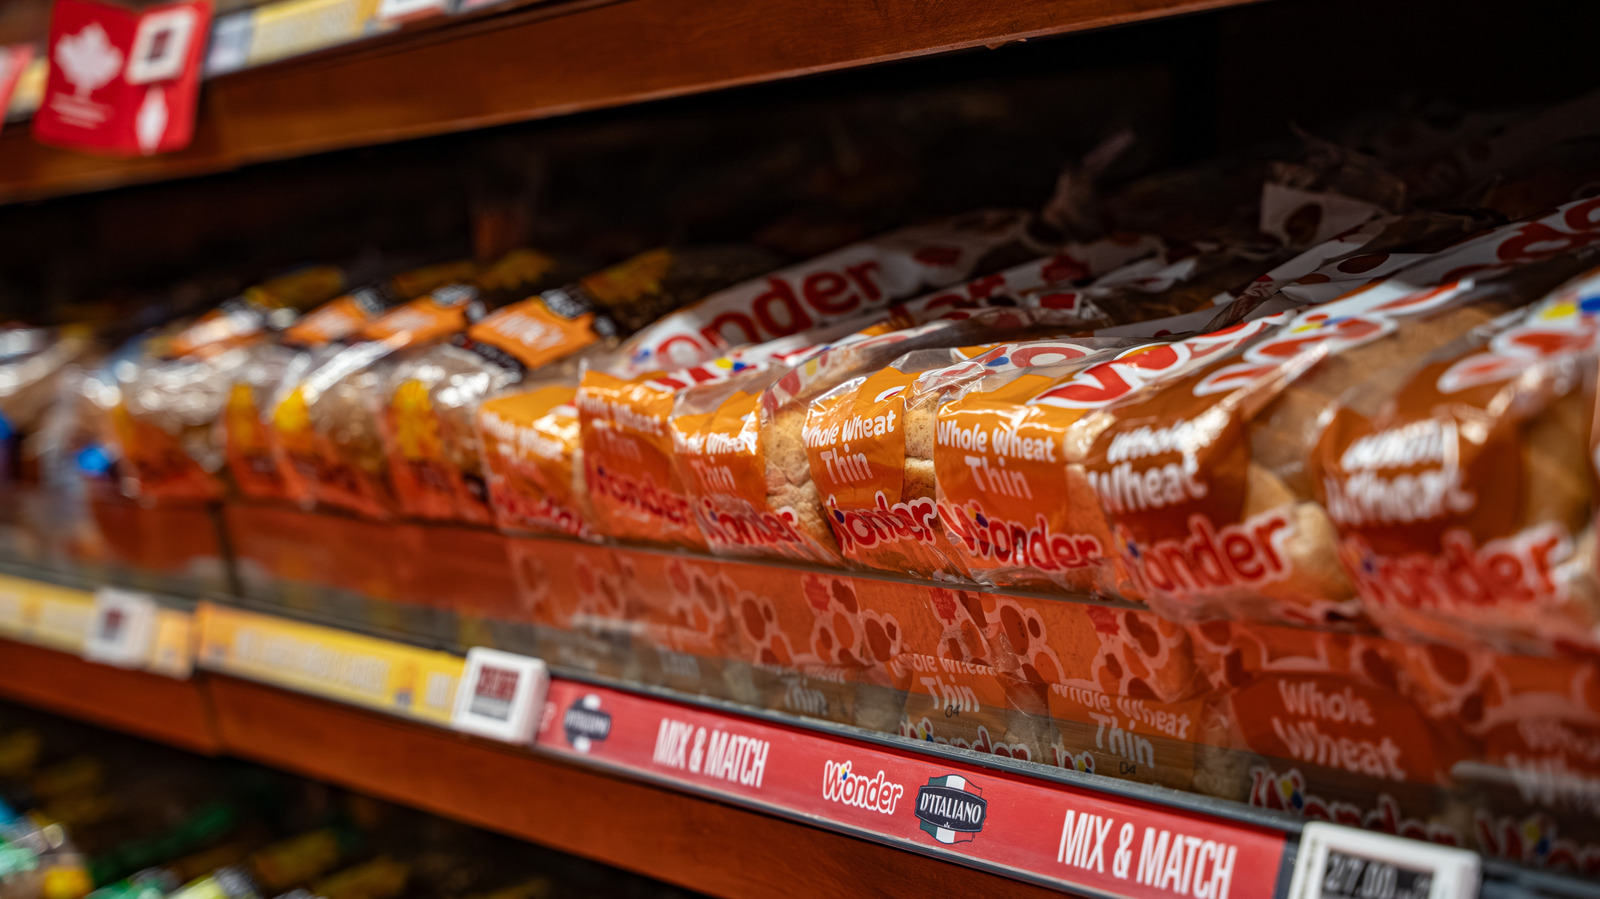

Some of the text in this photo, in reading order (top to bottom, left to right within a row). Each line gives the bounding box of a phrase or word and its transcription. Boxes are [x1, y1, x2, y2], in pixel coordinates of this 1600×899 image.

[841, 409, 897, 442] Wheat
[936, 419, 1056, 463] Whole Wheat
[820, 443, 874, 485] Thin
[964, 455, 1034, 500] Thin
[936, 499, 1103, 574] Wonder
[919, 674, 980, 713] Thin
[1278, 679, 1375, 726] Whole
[1088, 711, 1155, 769] Thin
[1117, 694, 1191, 740] Wheat
[653, 718, 694, 770] MIX
[688, 726, 707, 774] &
[703, 729, 770, 788] MATCH
[1271, 716, 1407, 782] Wheat
[823, 760, 904, 815] Wonder
[919, 792, 982, 825] D'ITALIANO
[1057, 809, 1238, 899] MIX & MATCH
